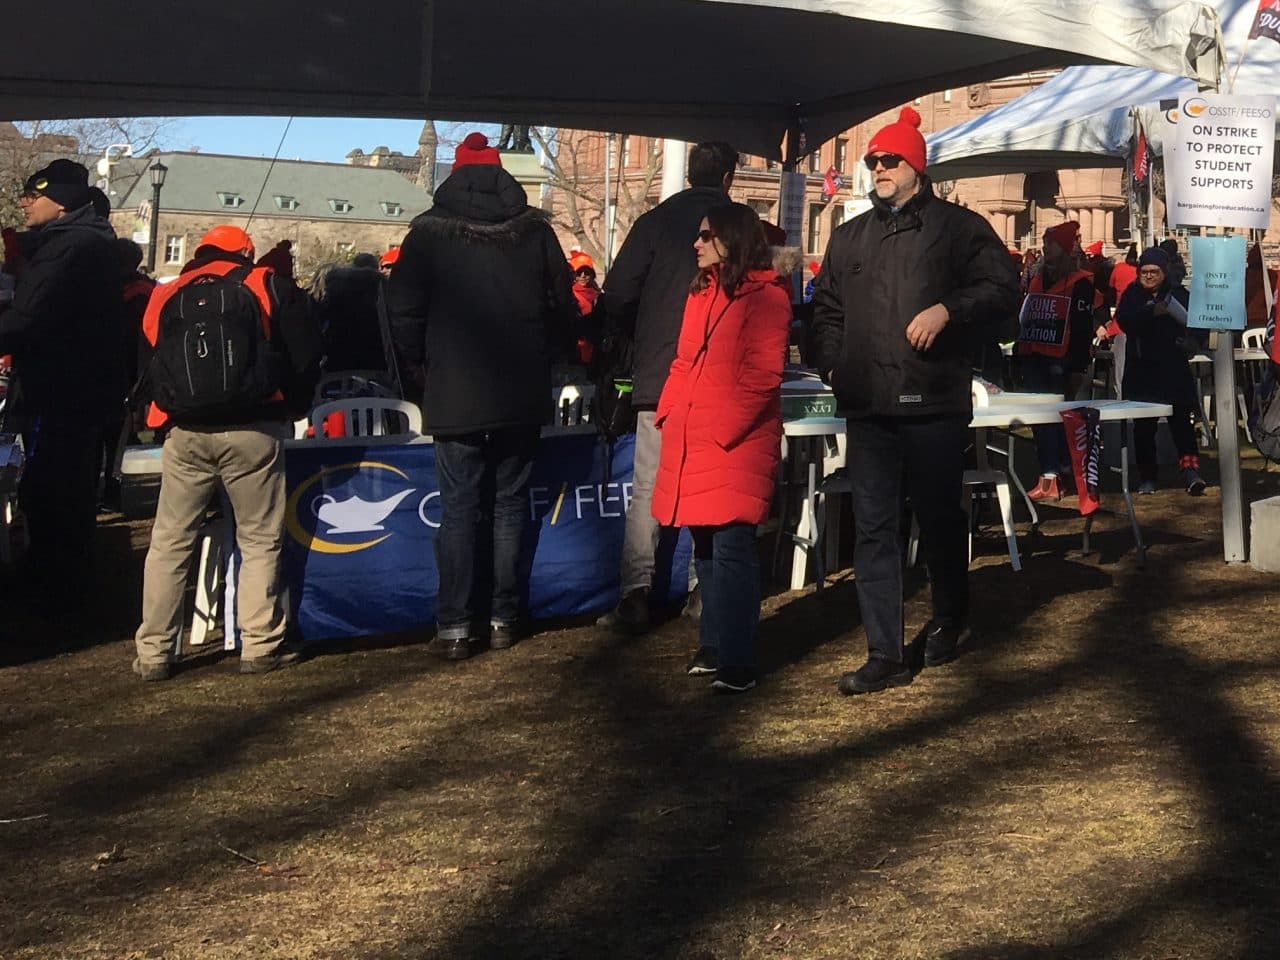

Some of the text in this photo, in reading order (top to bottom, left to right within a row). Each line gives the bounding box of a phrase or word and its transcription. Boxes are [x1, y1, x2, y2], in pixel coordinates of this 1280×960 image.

[1192, 124, 1258, 138] ON STRIKE
[1186, 141, 1264, 156] TO PROTECT
[1194, 159, 1253, 172] STUDENT
[1190, 176, 1255, 190] SUPPORTS
